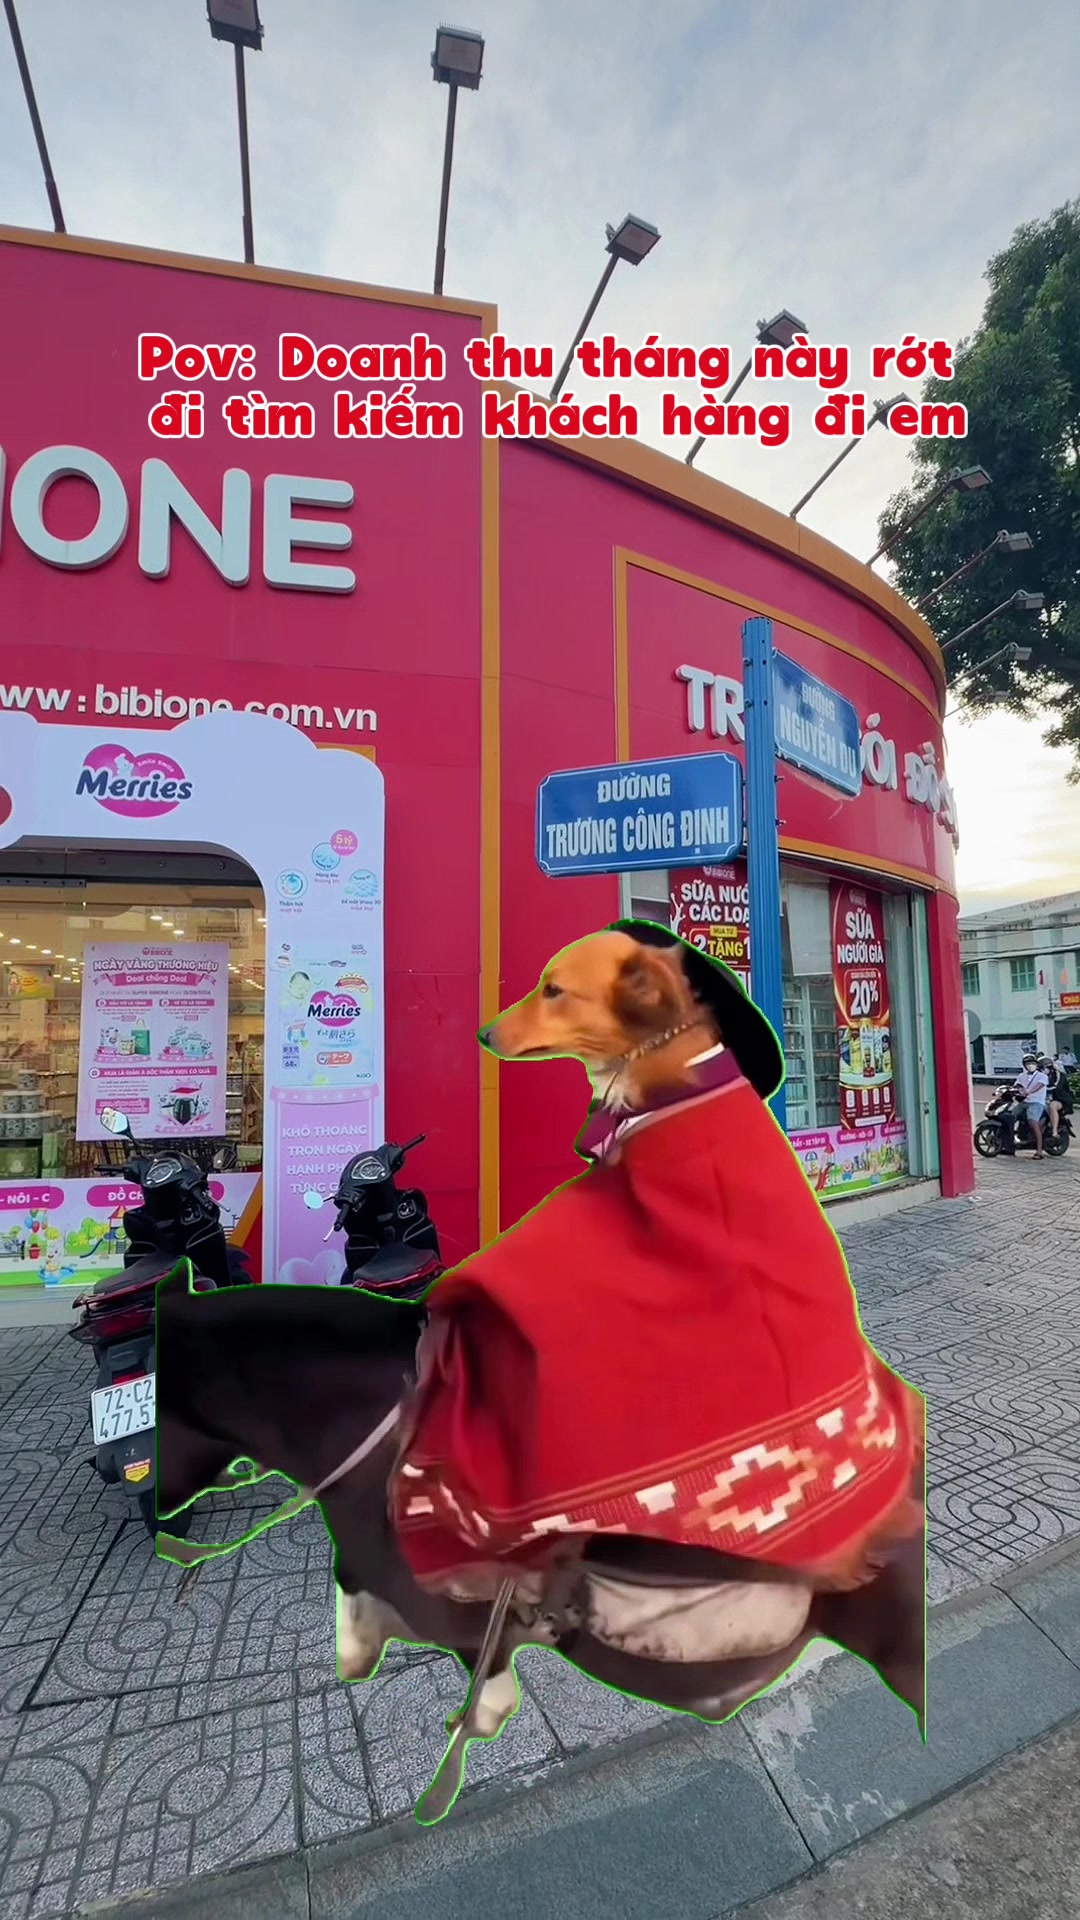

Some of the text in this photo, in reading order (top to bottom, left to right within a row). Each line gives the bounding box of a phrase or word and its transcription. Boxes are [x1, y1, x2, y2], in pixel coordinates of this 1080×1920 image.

[0, 443, 356, 592] ONE
[675, 664, 745, 741] TR
[780, 704, 857, 778] NGUYỄN DU
[76, 769, 193, 800] Merries
[597, 772, 671, 804] ĐƯỜNG
[546, 805, 730, 859] TRƯƠNG CÔNG ĐỊNH
[680, 879, 716, 902] SỮA
[689, 900, 722, 922] CÁC
[845, 907, 875, 940] SỮA
[708, 938, 744, 960] TẶNG
[837, 940, 884, 964] NGƯỜI GIÀ
[93, 957, 125, 972] NGÀY
[126, 957, 156, 971] VÀNG
[157, 959, 196, 971] THƯƠNG
[849, 979, 879, 1017] 20%
[307, 1004, 361, 1017] Merries
[282, 1122, 368, 1138] KHÔ THOÁNG
[288, 1141, 362, 1158] TRỌN NGÀY
[287, 1163, 324, 1177] HẠNH
[7, 1192, 31, 1204] NÔI
[107, 1186, 127, 1201] ĐỒ
[99, 1401, 156, 1438] 477.5
